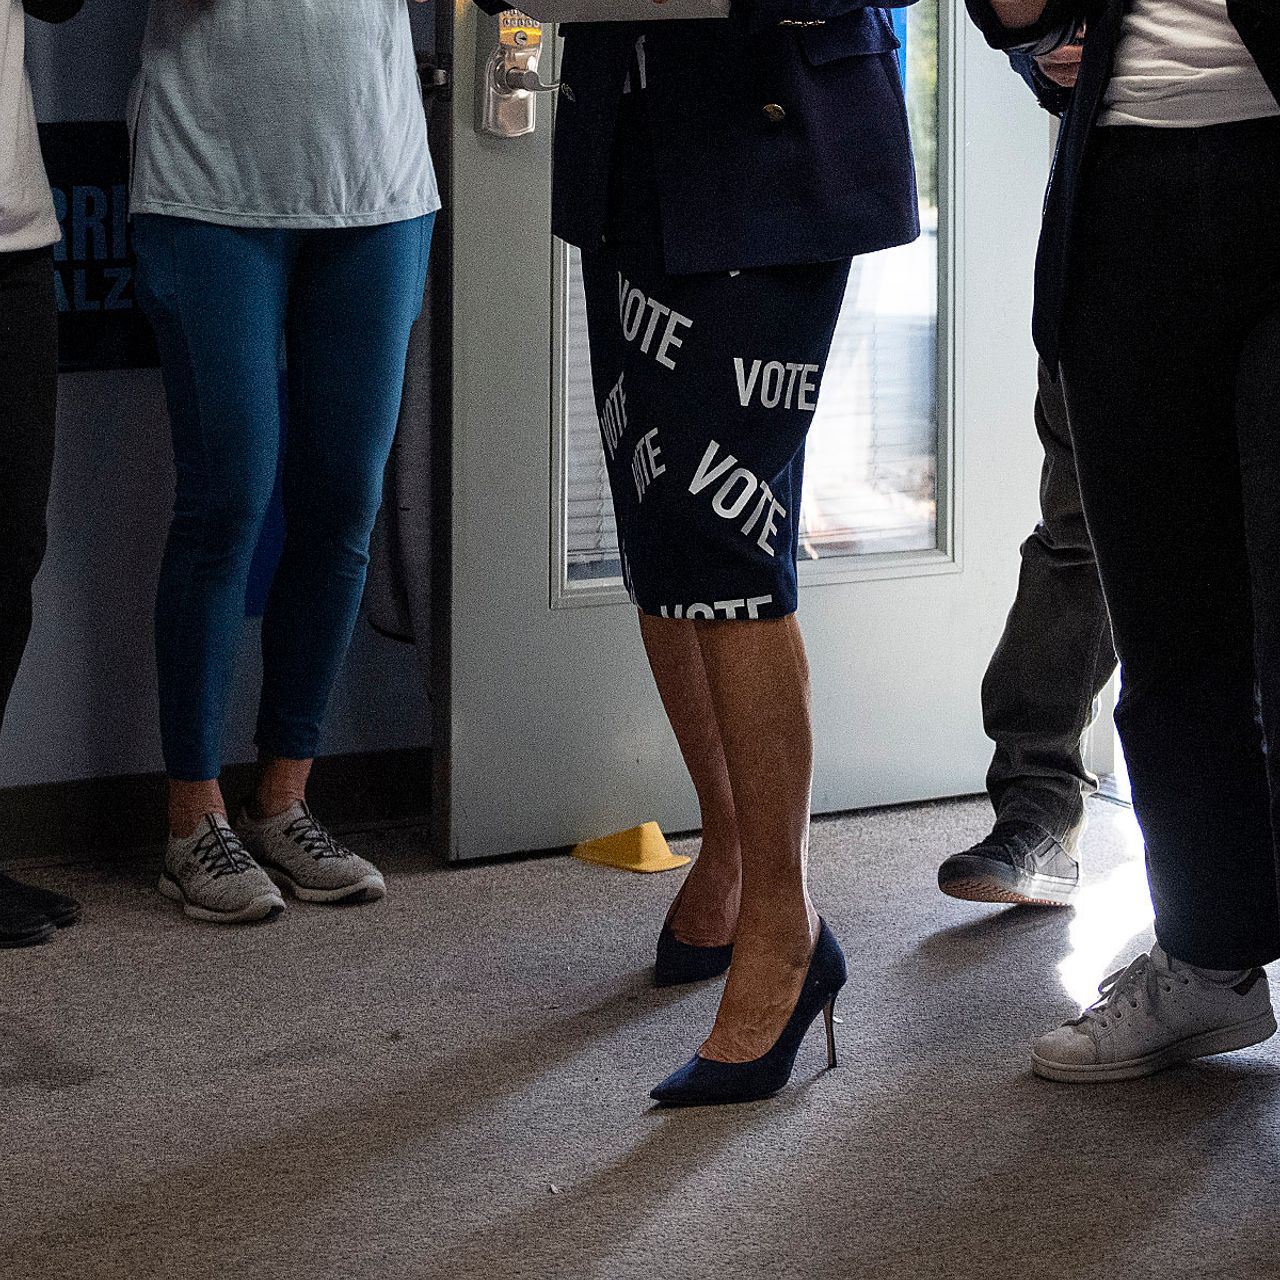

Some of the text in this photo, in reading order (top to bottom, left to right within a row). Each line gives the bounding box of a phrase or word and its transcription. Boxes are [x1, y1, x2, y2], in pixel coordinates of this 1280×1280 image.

[618, 271, 694, 371] VOTE
[733, 356, 819, 412] VOTE
[687, 439, 787, 557] VOTE
